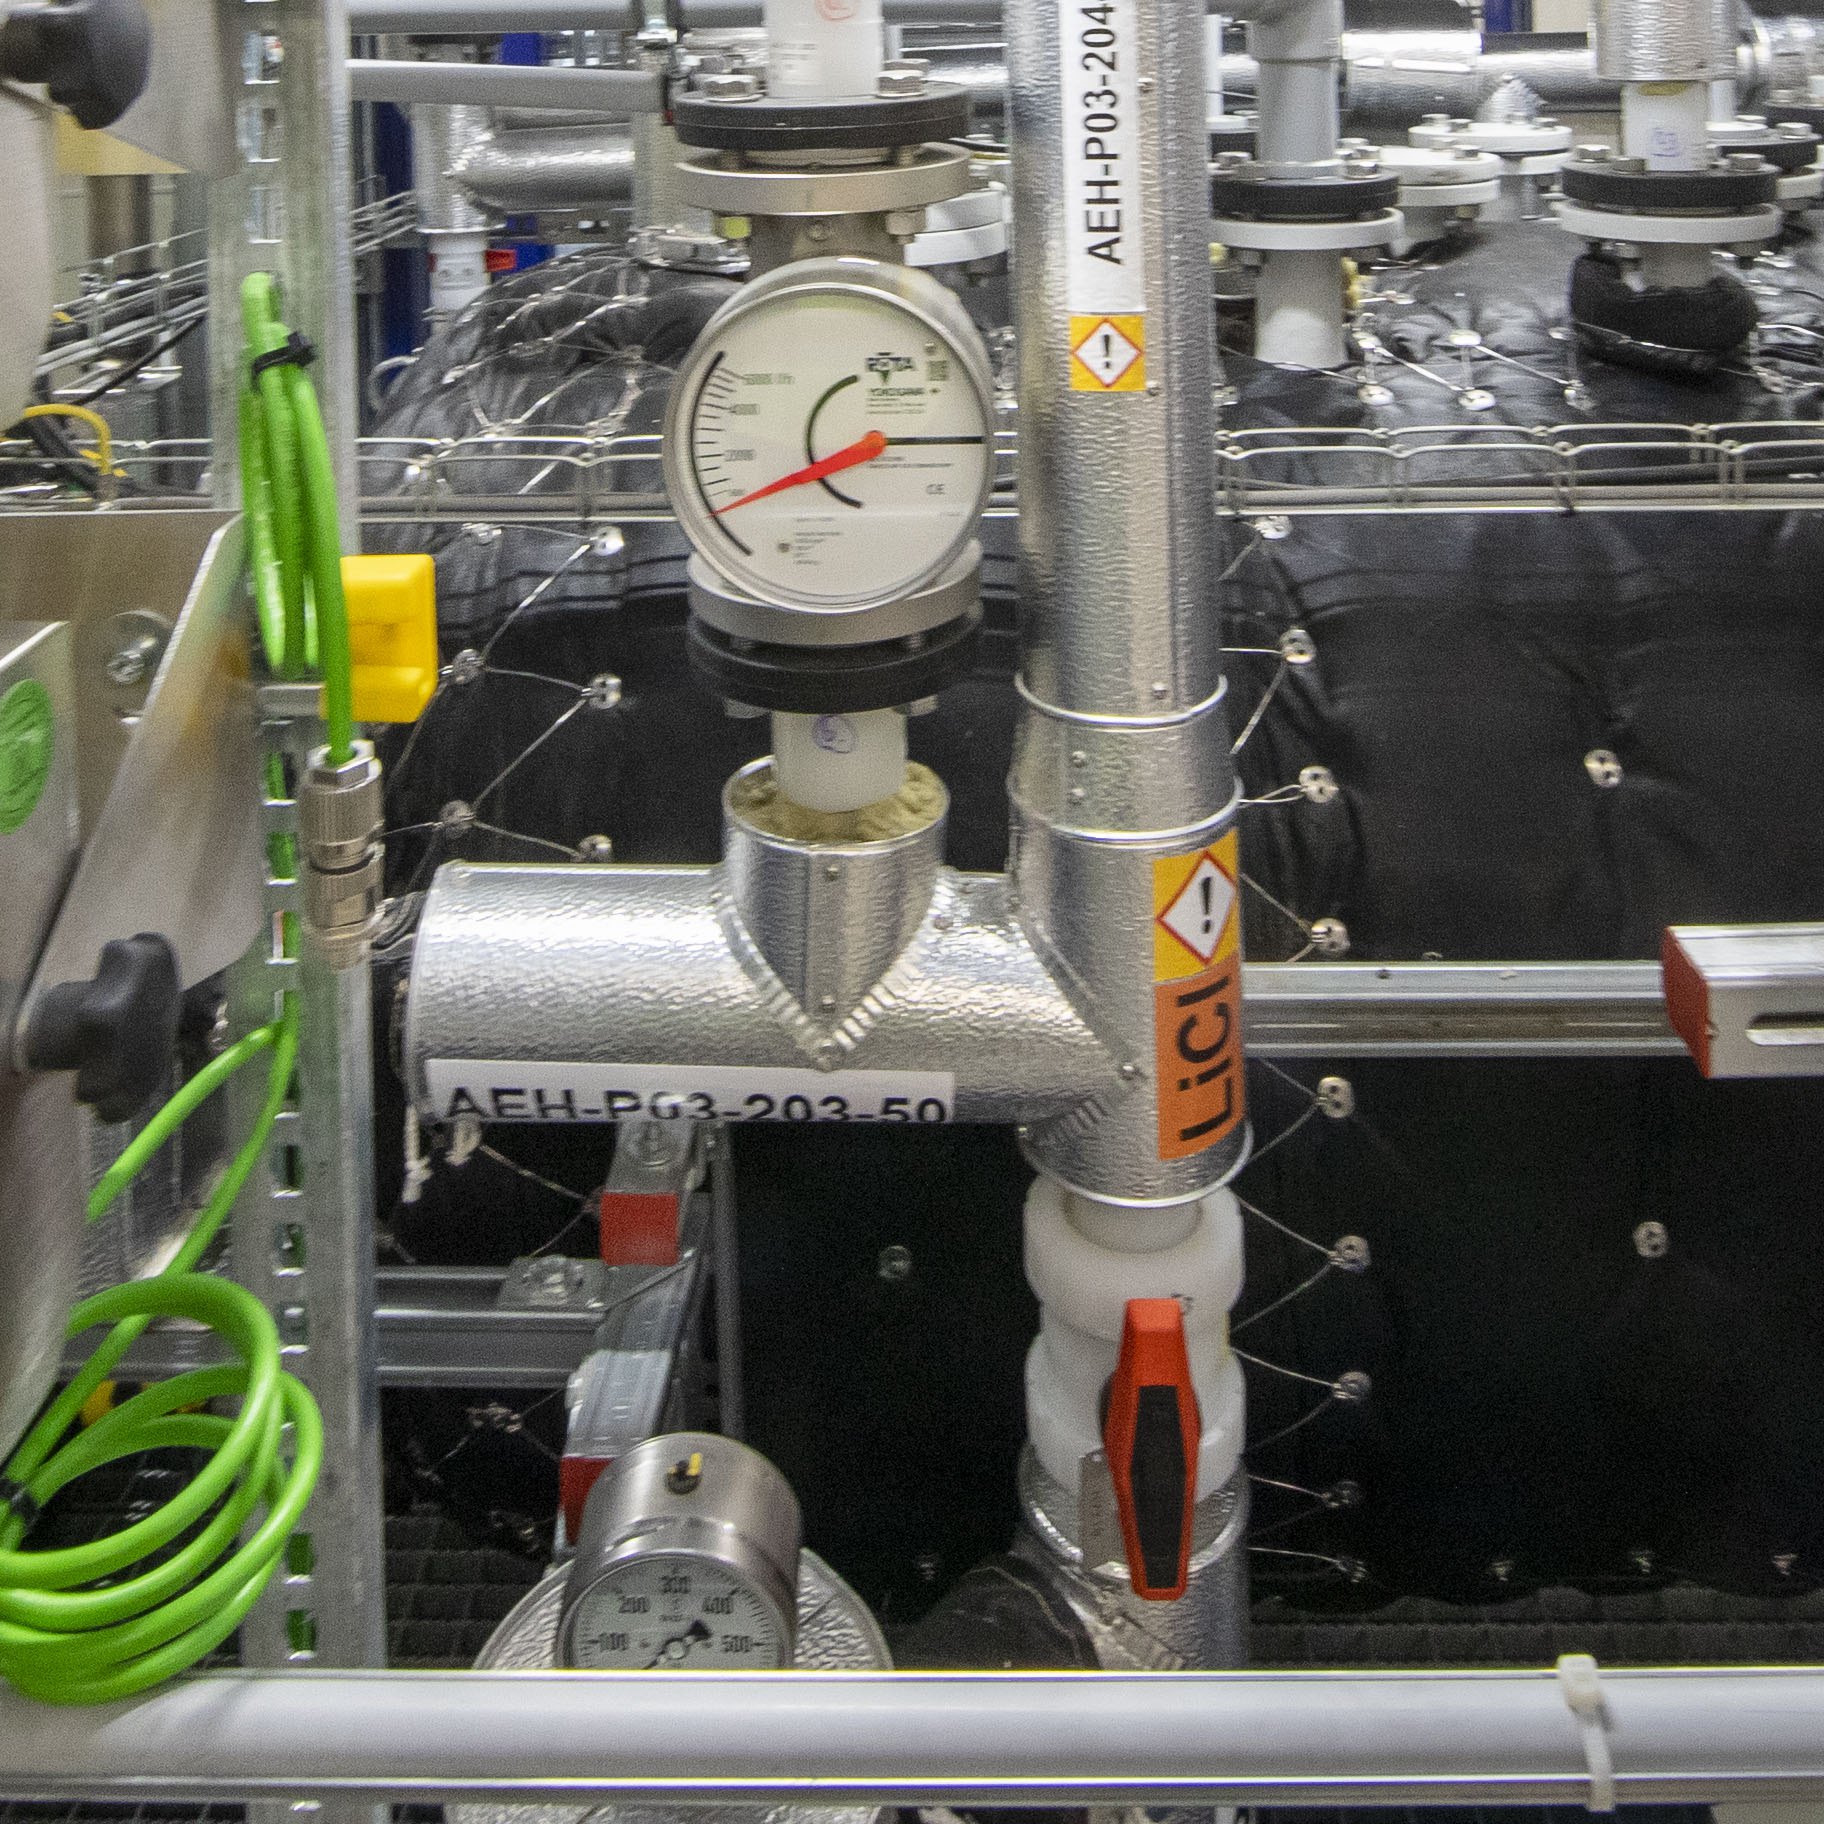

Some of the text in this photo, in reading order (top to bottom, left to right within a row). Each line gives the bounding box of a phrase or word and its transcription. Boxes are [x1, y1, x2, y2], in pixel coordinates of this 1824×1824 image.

[1177, 976, 1233, 1146] LiCl
[444, 1086, 949, 1123] AEH-P03-203-50
[618, 1595, 651, 1614] 200
[701, 1596, 734, 1614] 400
[598, 1631, 628, 1652] 100
[721, 1633, 754, 1653] 500
